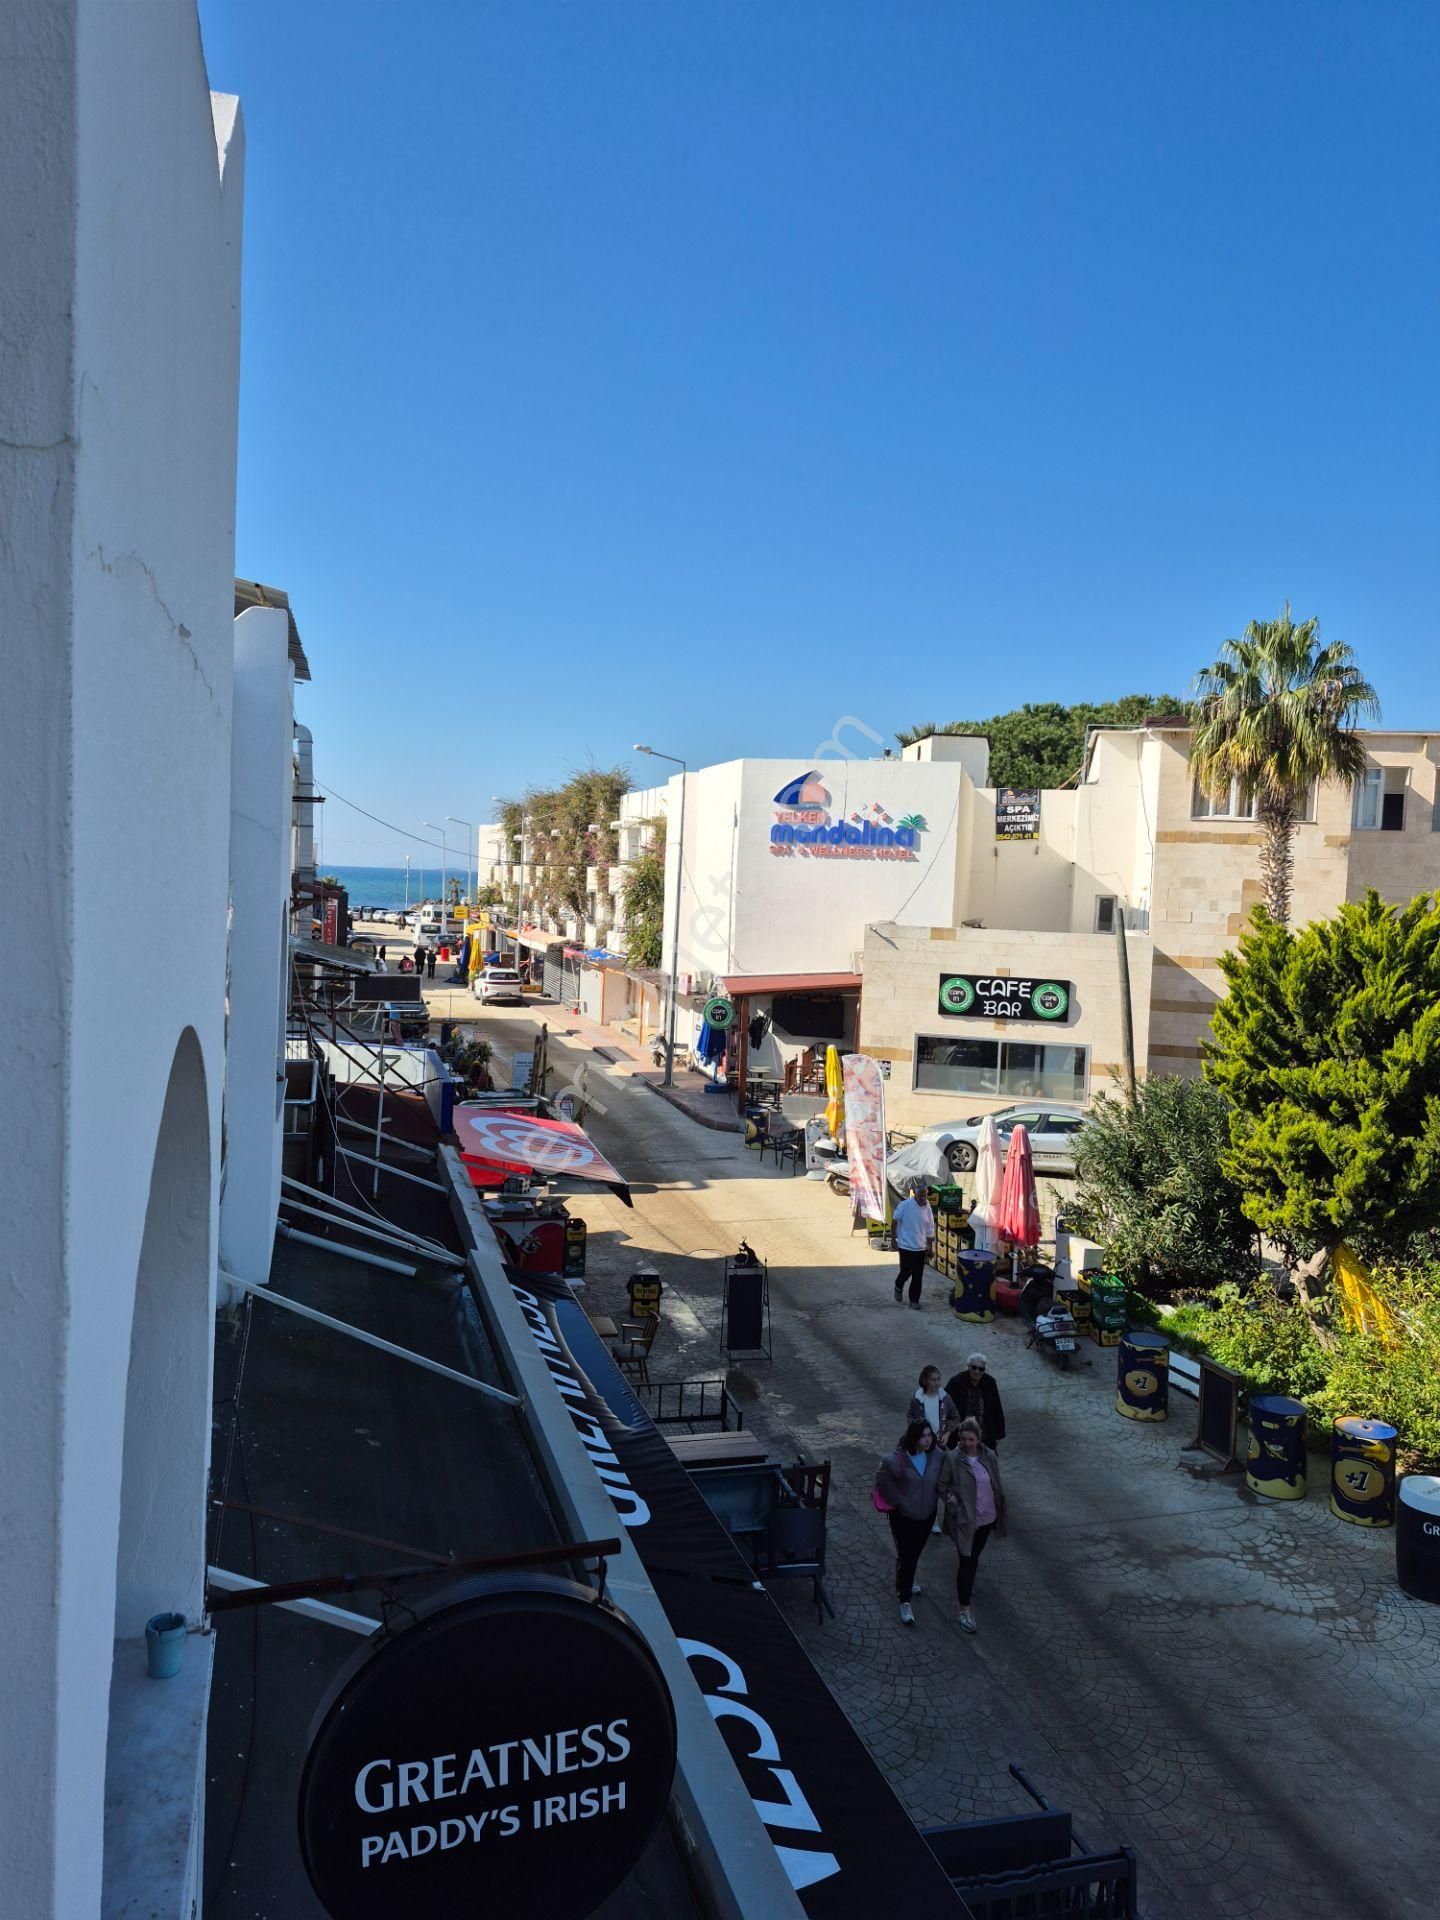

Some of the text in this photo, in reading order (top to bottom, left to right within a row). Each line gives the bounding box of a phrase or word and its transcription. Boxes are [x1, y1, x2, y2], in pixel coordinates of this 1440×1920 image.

[1006, 805, 1031, 814] SPA
[774, 812, 827, 824] YELKEN
[809, 846, 871, 857] WELLNESS
[975, 979, 1032, 999] CAFE
[983, 1000, 1022, 1016] BAR
[1134, 1377, 1148, 1391] +1
[1345, 1471, 1370, 1493] +1
[354, 1718, 631, 1814] GREATNESS
[361, 1781, 627, 1868] PADDY'S IRISH
